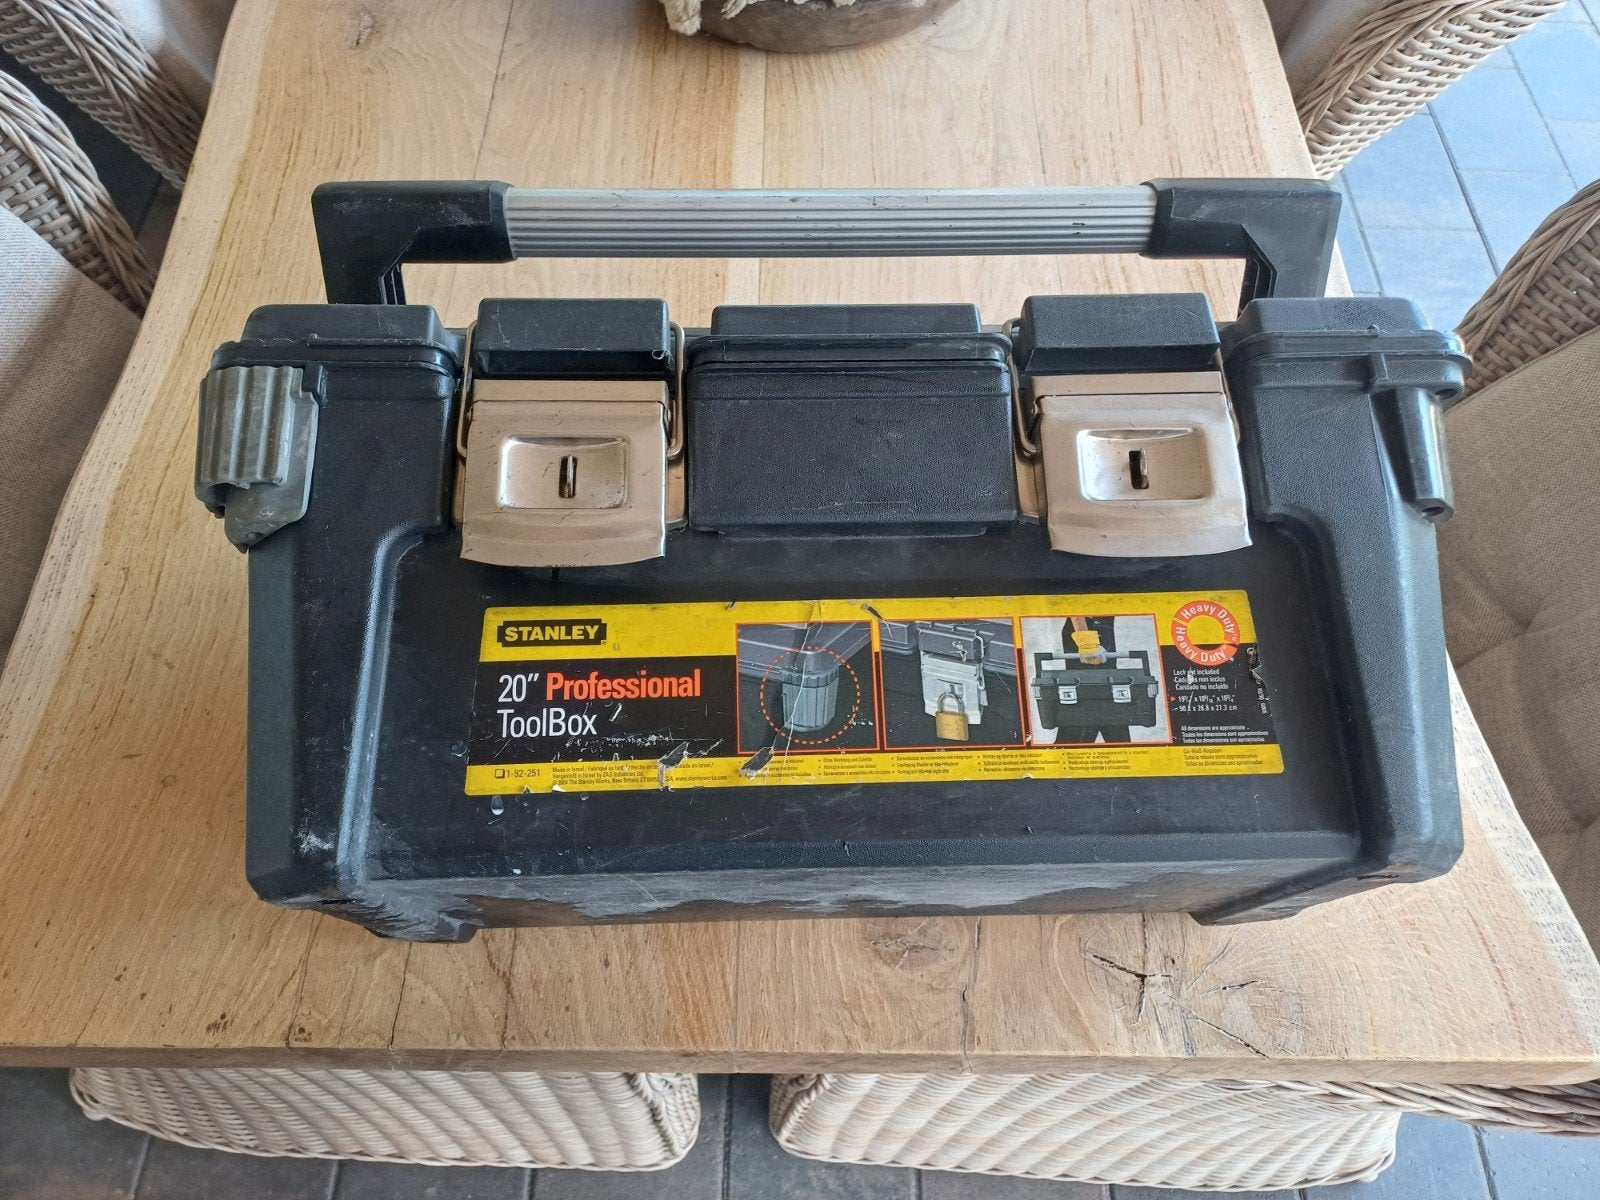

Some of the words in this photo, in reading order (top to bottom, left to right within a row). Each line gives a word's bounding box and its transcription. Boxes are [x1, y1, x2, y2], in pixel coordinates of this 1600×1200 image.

[1180, 604, 1217, 620] Heavy
[504, 625, 600, 642] STANLEY
[1175, 626, 1198, 660] Heavy
[498, 673, 540, 703] 20"
[546, 668, 701, 701] Professional
[497, 707, 598, 738] ToolBox
[507, 768, 541, 778] 1-92-251
